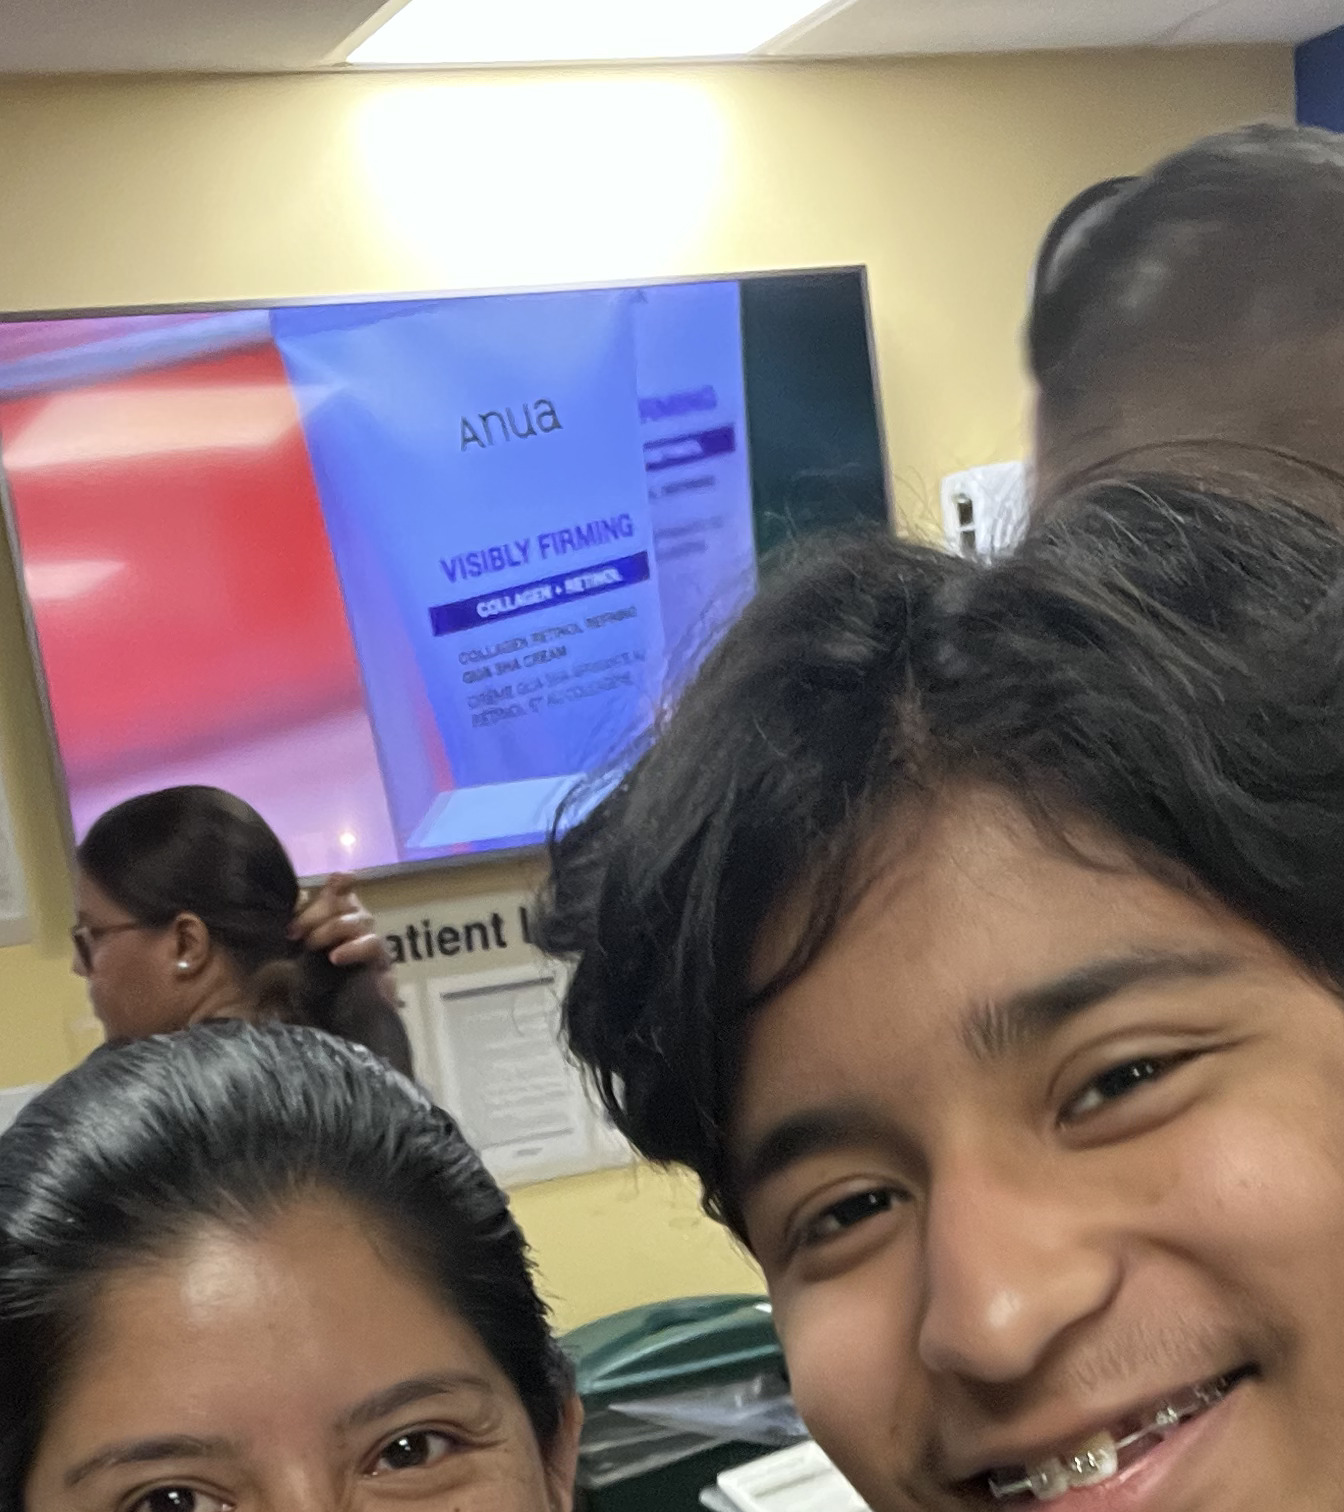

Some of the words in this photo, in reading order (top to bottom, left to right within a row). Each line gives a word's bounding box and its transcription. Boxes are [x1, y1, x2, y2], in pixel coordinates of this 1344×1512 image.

[459, 399, 563, 451] Anua
[440, 537, 531, 583] VISIBLY
[537, 513, 634, 560] FIRMING
[476, 585, 552, 618] COLLAGEN
[385, 912, 508, 964] atient
